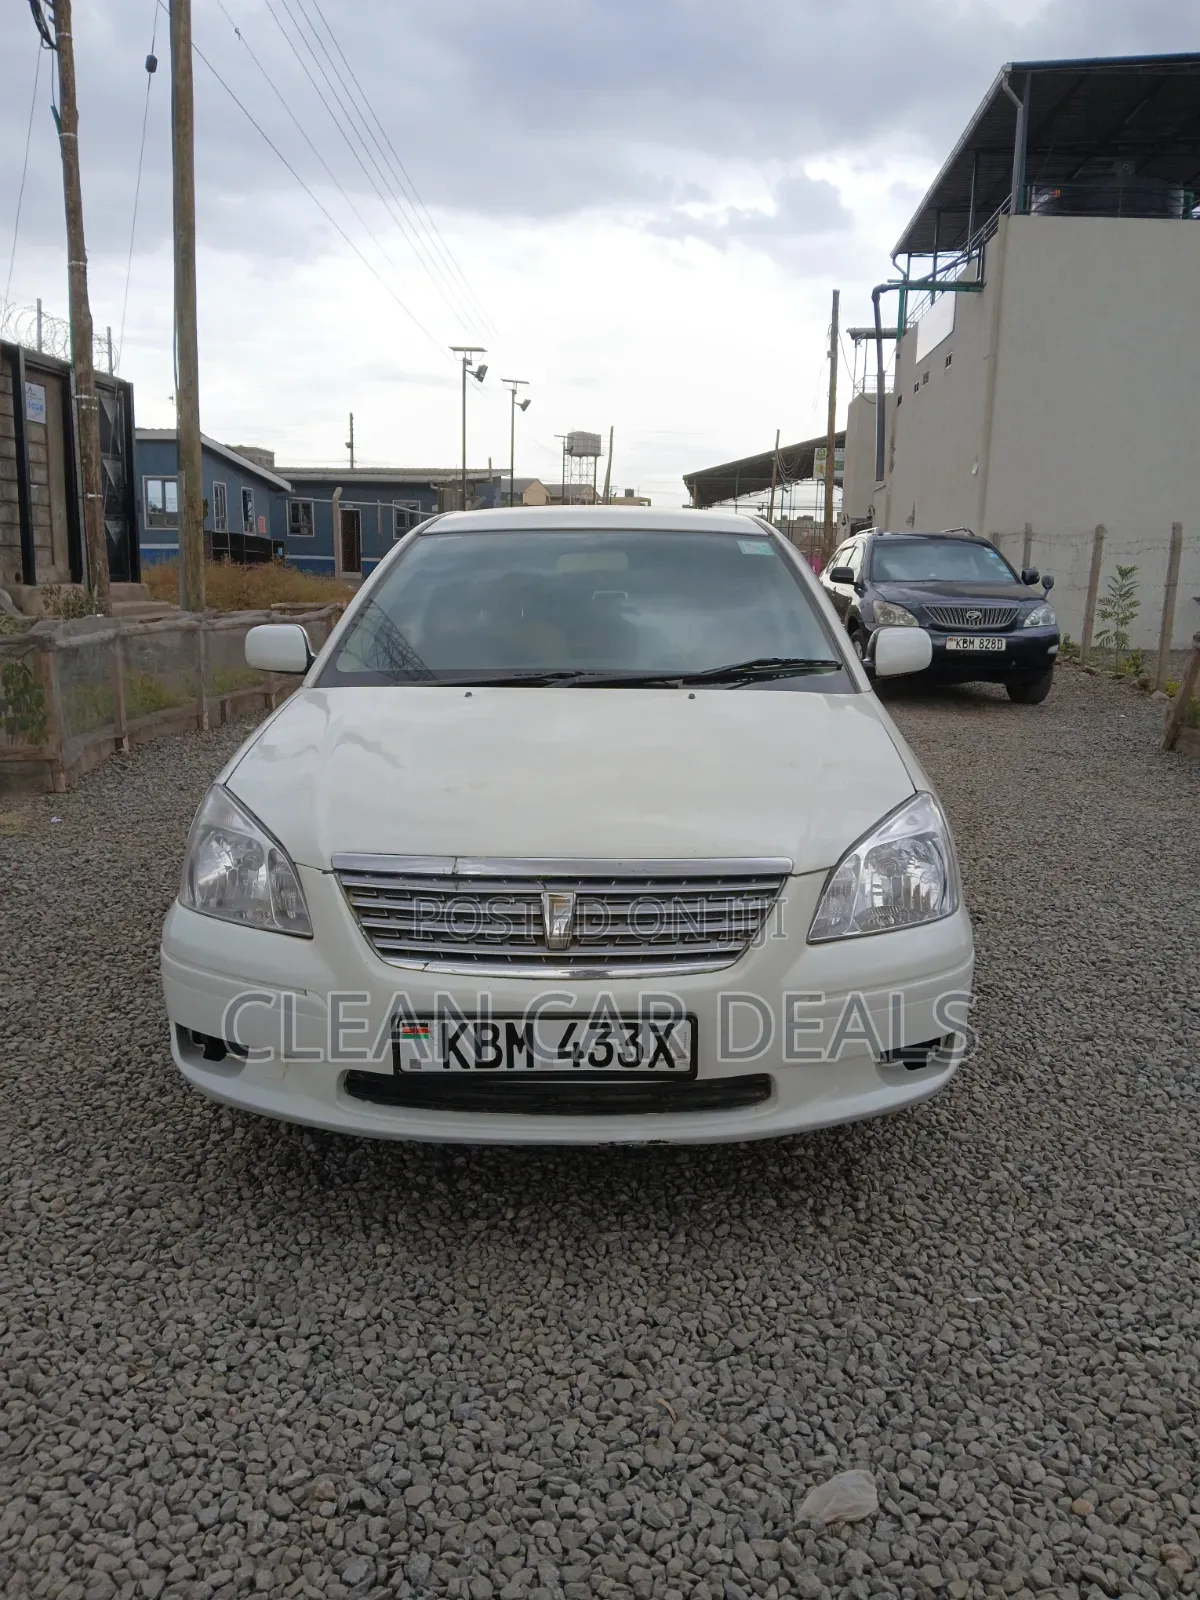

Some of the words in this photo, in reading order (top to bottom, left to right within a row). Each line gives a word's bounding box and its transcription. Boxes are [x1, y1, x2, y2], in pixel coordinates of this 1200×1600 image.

[955, 638, 975, 649] KBM
[979, 638, 1004, 650] 828D
[441, 1022, 534, 1070] KBM
[556, 1022, 676, 1070] 433X
